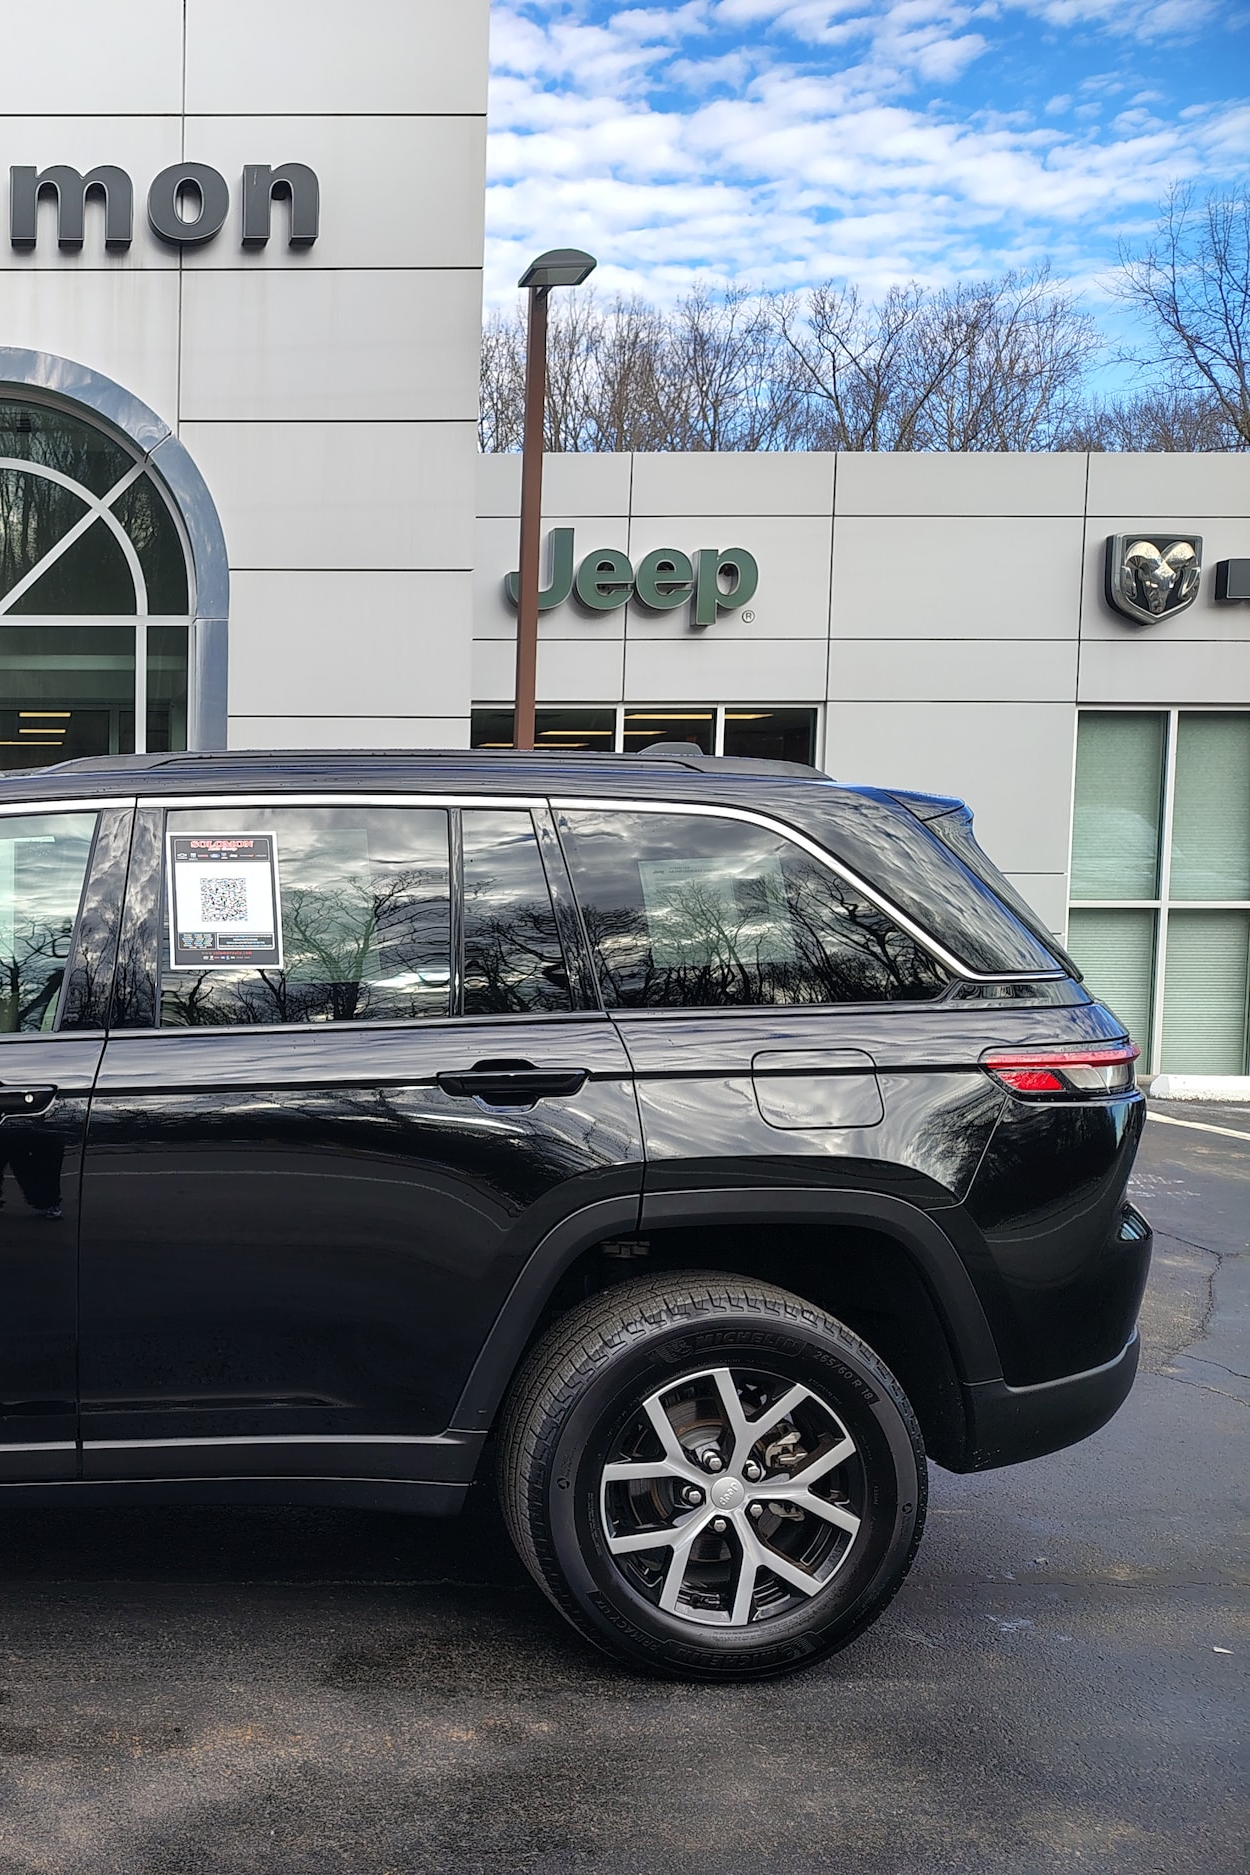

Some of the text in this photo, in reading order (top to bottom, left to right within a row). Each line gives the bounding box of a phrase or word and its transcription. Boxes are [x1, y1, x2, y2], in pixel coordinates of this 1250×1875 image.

[505, 527, 759, 627] Jeep
[696, 1330, 800, 1350] MICHELIN
[812, 1350, 854, 1379] 265/60
